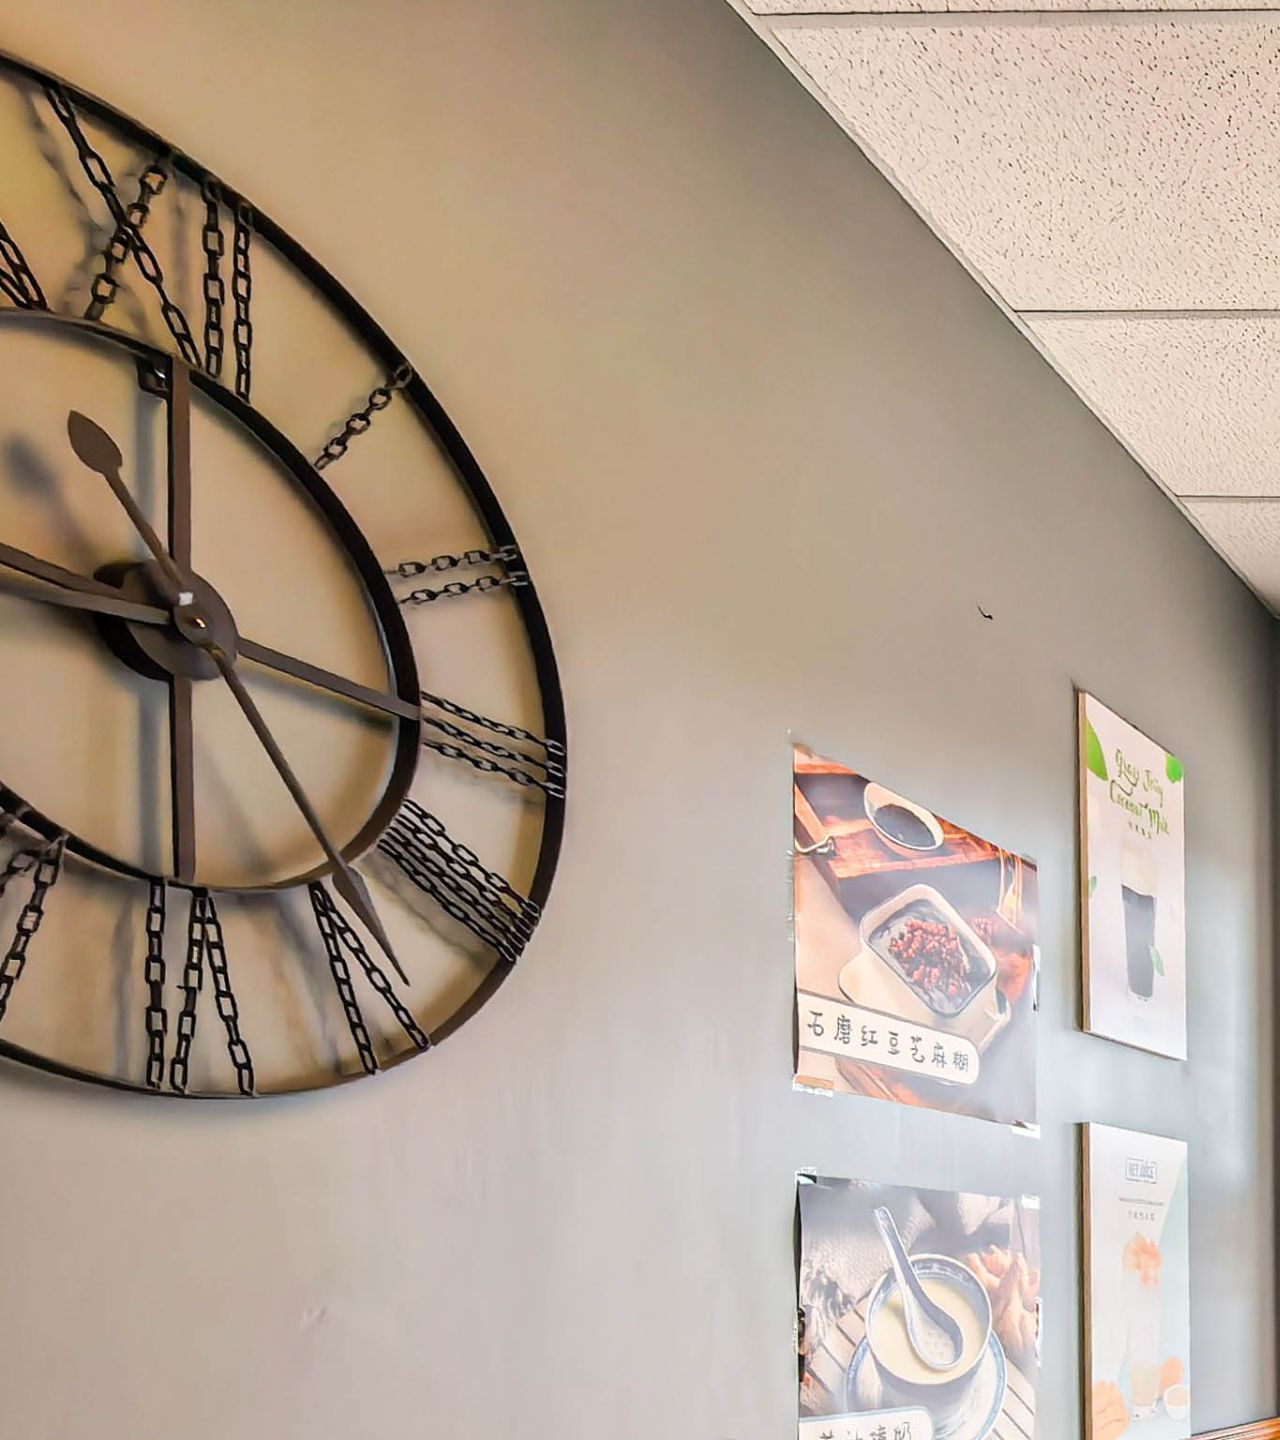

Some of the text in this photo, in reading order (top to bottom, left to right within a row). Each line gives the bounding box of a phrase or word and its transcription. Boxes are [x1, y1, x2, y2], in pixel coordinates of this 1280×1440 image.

[807, 1010, 969, 1072] 石磨红豆芝麻糊
